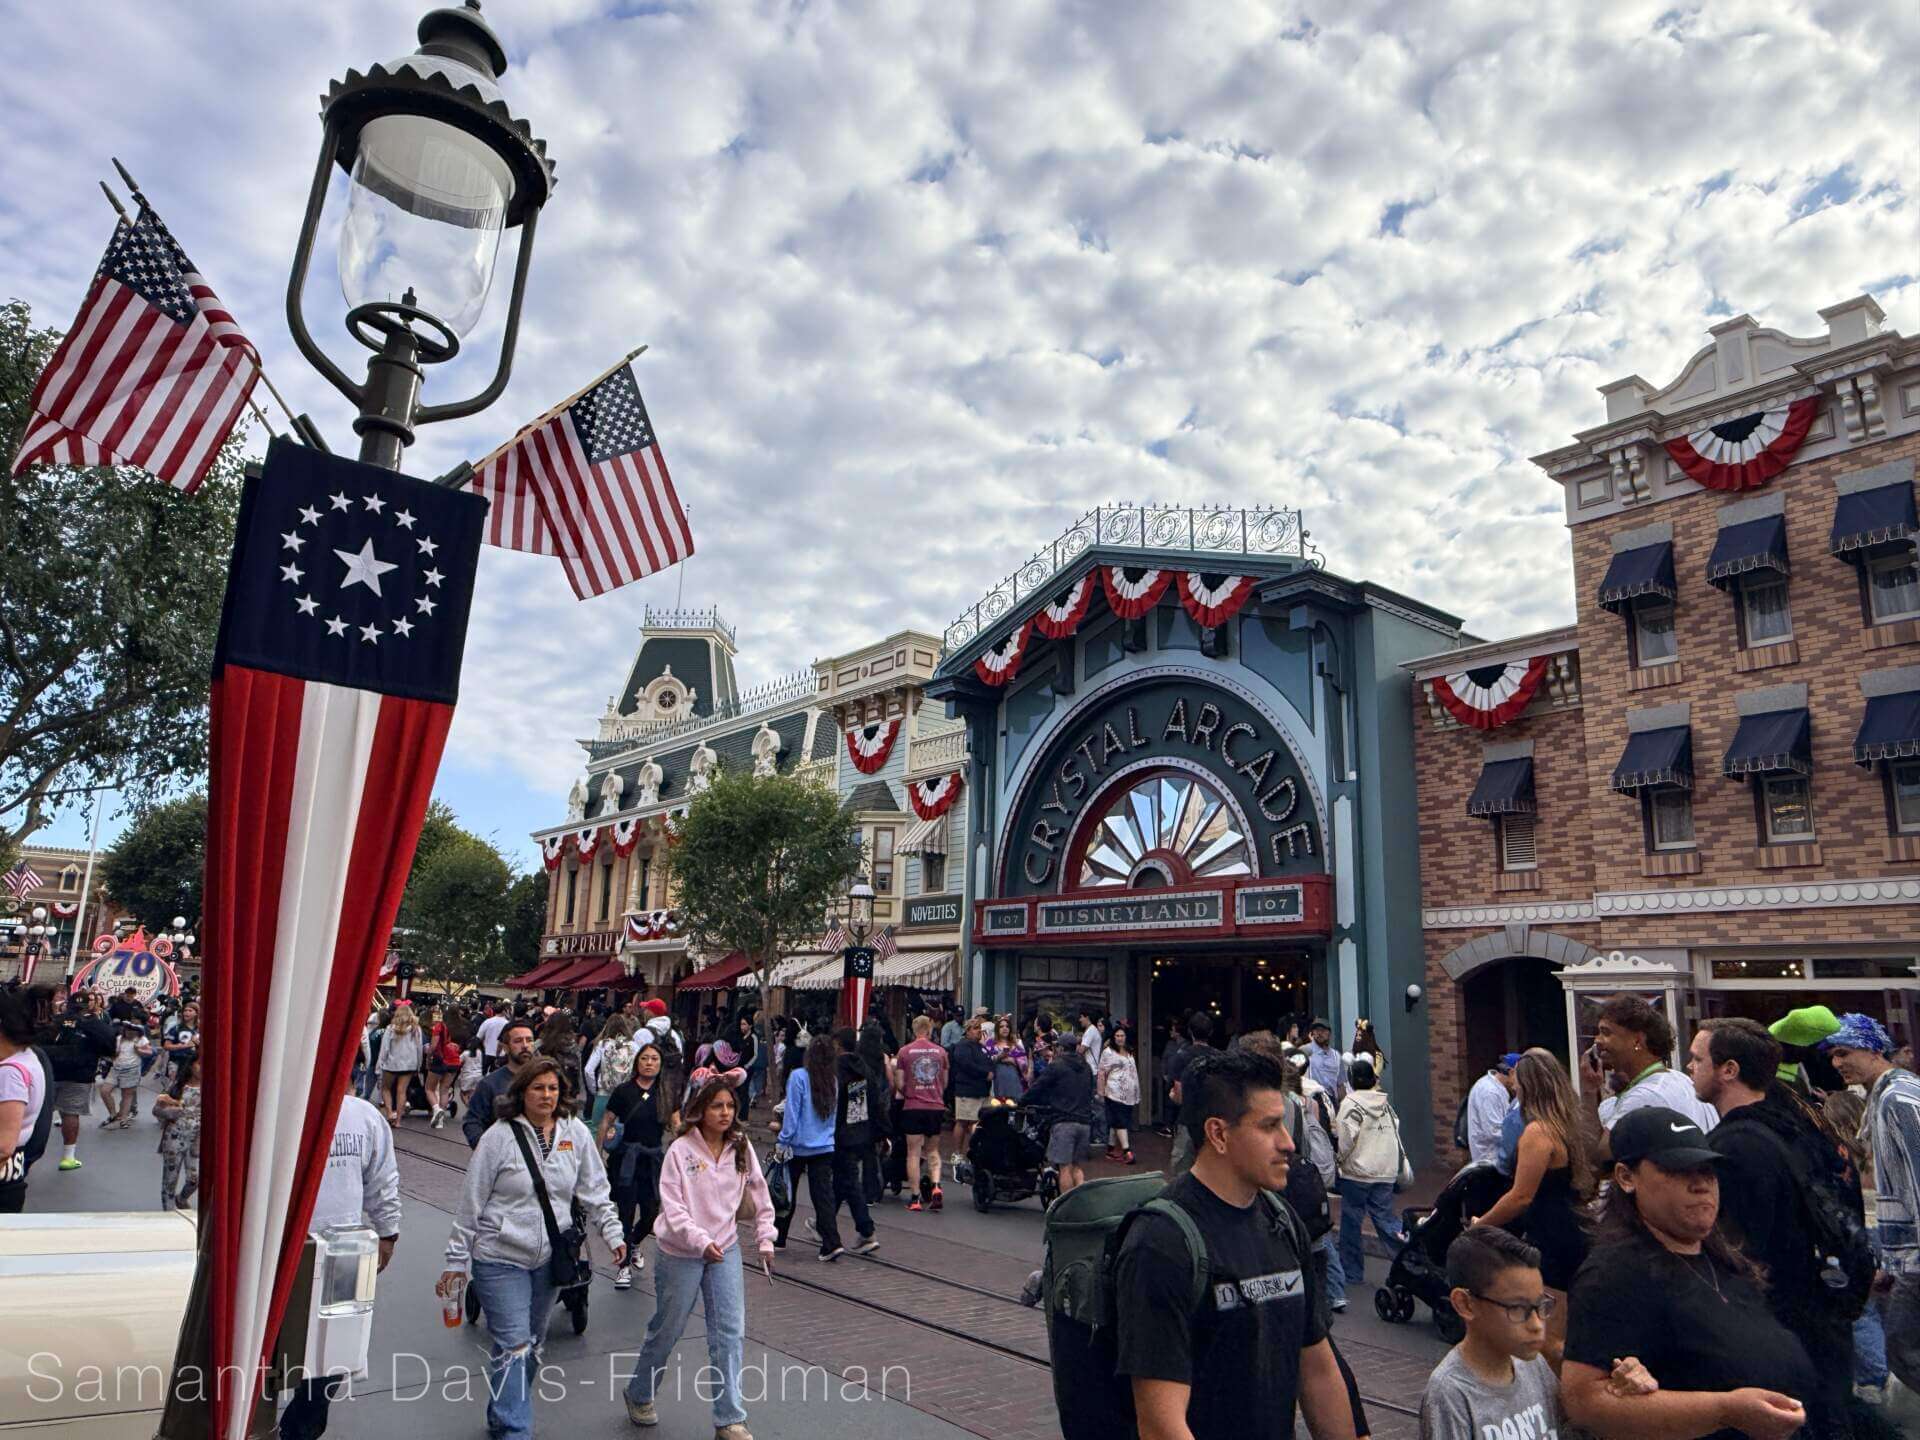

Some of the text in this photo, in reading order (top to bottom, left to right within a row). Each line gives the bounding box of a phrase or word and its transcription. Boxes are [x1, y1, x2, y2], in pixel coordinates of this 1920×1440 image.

[1024, 696, 1313, 885] CRYSTAL ARCADE
[911, 903, 957, 922] NOVELTIES
[1053, 902, 1208, 924] DISNEYLAND
[1257, 898, 1288, 911] 107
[112, 950, 155, 977] 70
